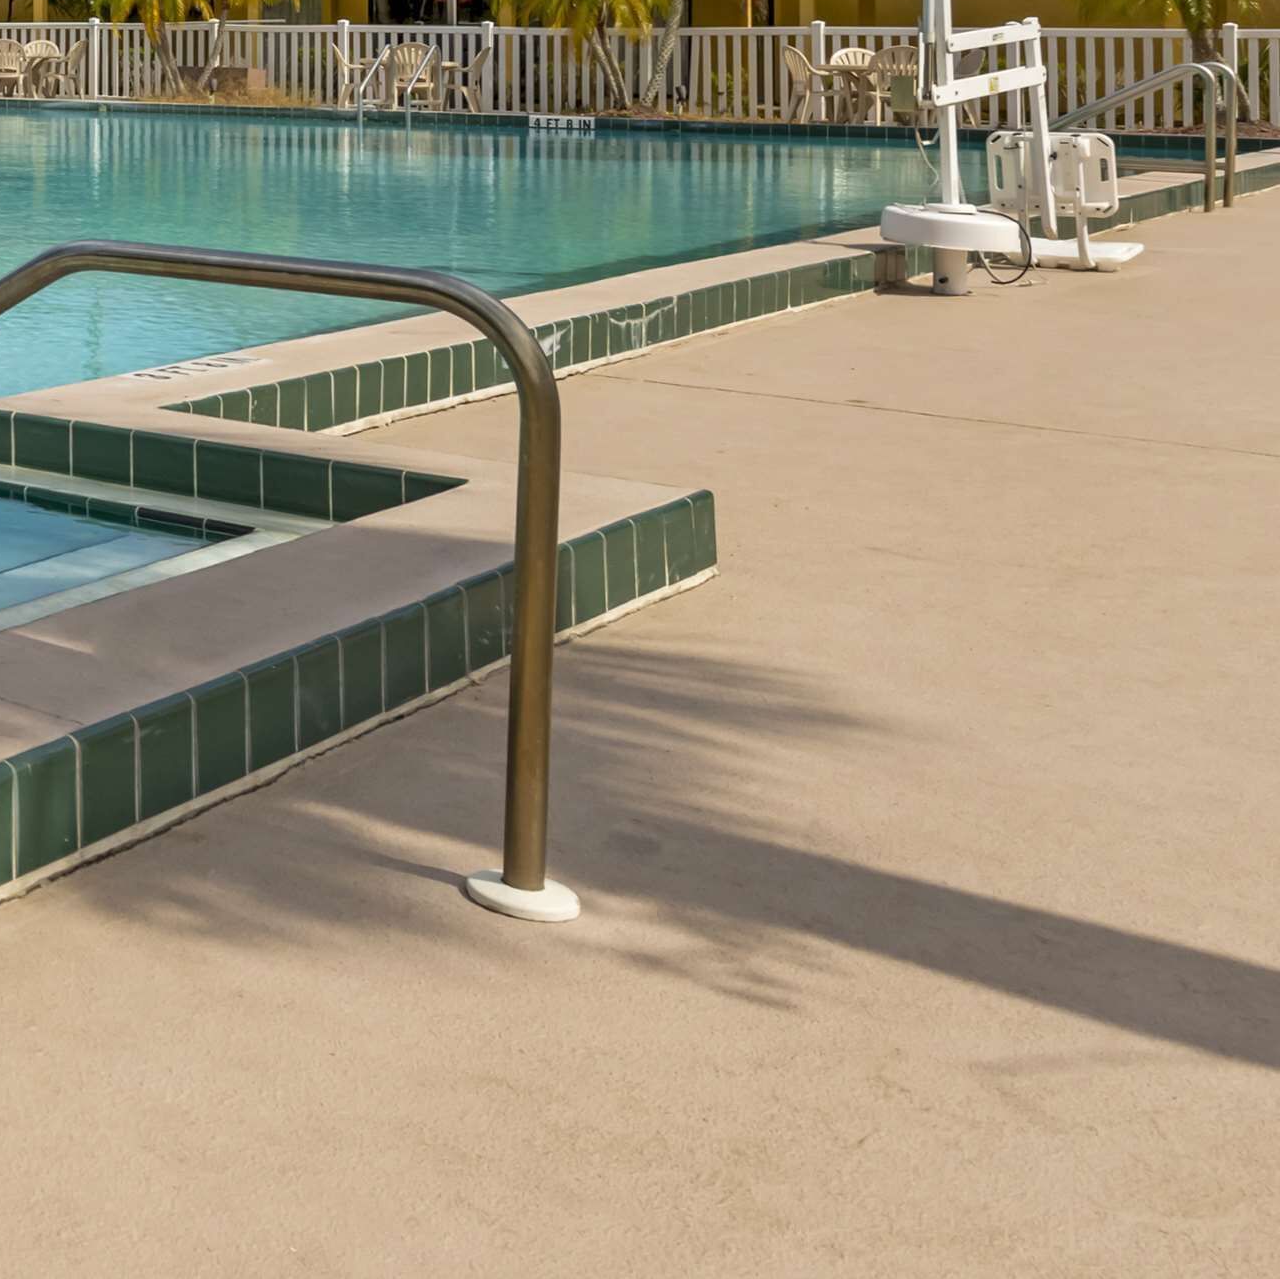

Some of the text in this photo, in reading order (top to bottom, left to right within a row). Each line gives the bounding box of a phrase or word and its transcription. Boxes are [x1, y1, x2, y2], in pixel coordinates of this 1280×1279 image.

[534, 118, 541, 127] 4
[546, 118, 560, 128] FT
[578, 120, 591, 129] IN
